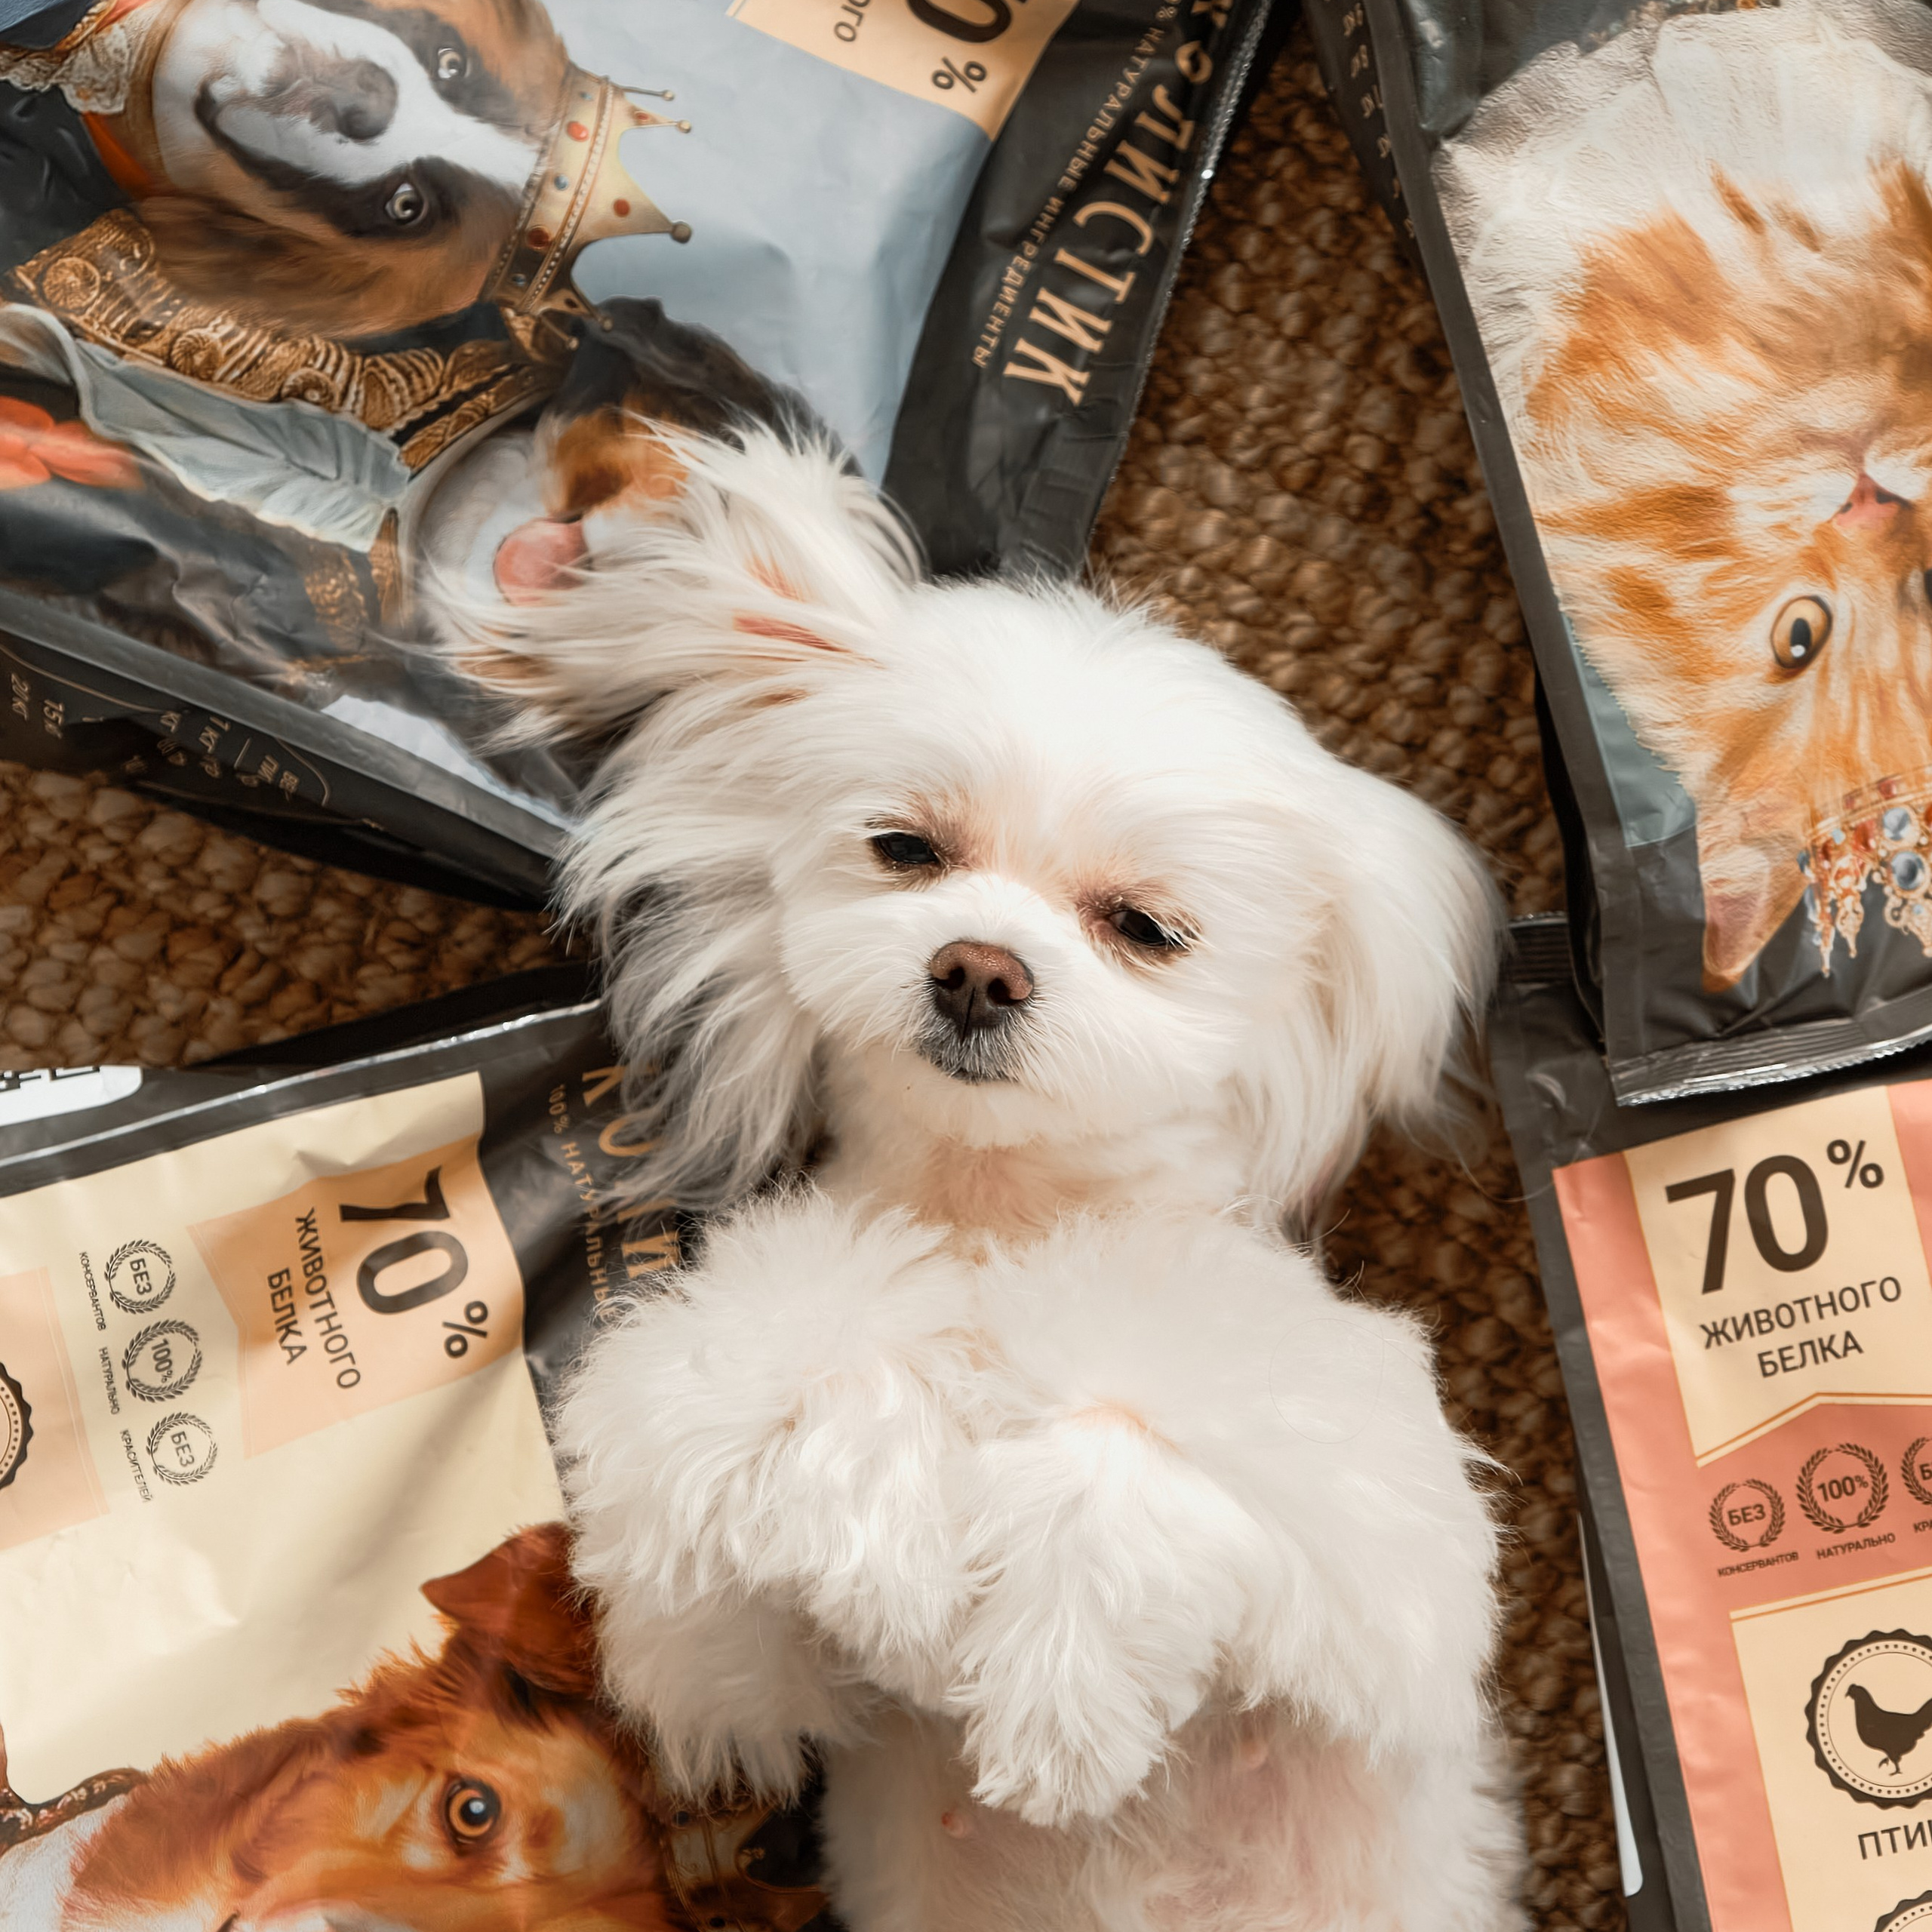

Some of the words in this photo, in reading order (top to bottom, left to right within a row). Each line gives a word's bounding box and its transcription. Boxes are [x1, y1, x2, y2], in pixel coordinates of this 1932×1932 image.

[1057, 27, 1165, 192] НАТУРАЛЬНЫЕ
[971, 195, 1065, 368] ИНГРЕДИЕНТЫ
[1665, 1139, 1885, 1296] 70%
[78, 1251, 106, 1332] КОНСЕРВАНТОВ
[129, 1257, 152, 1296] БЕЗ
[338, 1164, 489, 1359] 70%
[266, 1267, 308, 1366] БЕЛКА
[295, 1207, 361, 1390] ЖИВОТНОГО
[1700, 1276, 1902, 1350] ЖИВОТНОГО
[98, 1346, 121, 1416] НАТУРАЛЬНО
[151, 1337, 176, 1384] 100%
[1757, 1330, 1865, 1378] БЕЛКА
[120, 1429, 153, 1504] КРАСИТЕЛЕЙ
[170, 1430, 195, 1469] БЕЗ
[1727, 1503, 1767, 1527] БЕЗ
[1817, 1474, 1869, 1503] 100%
[1717, 1551, 1800, 1577] КОНСЕРВАНТОВ
[1816, 1532, 1897, 1560] НАТУРАЛЬНО
[1857, 1819, 1932, 1860] ПТИ
